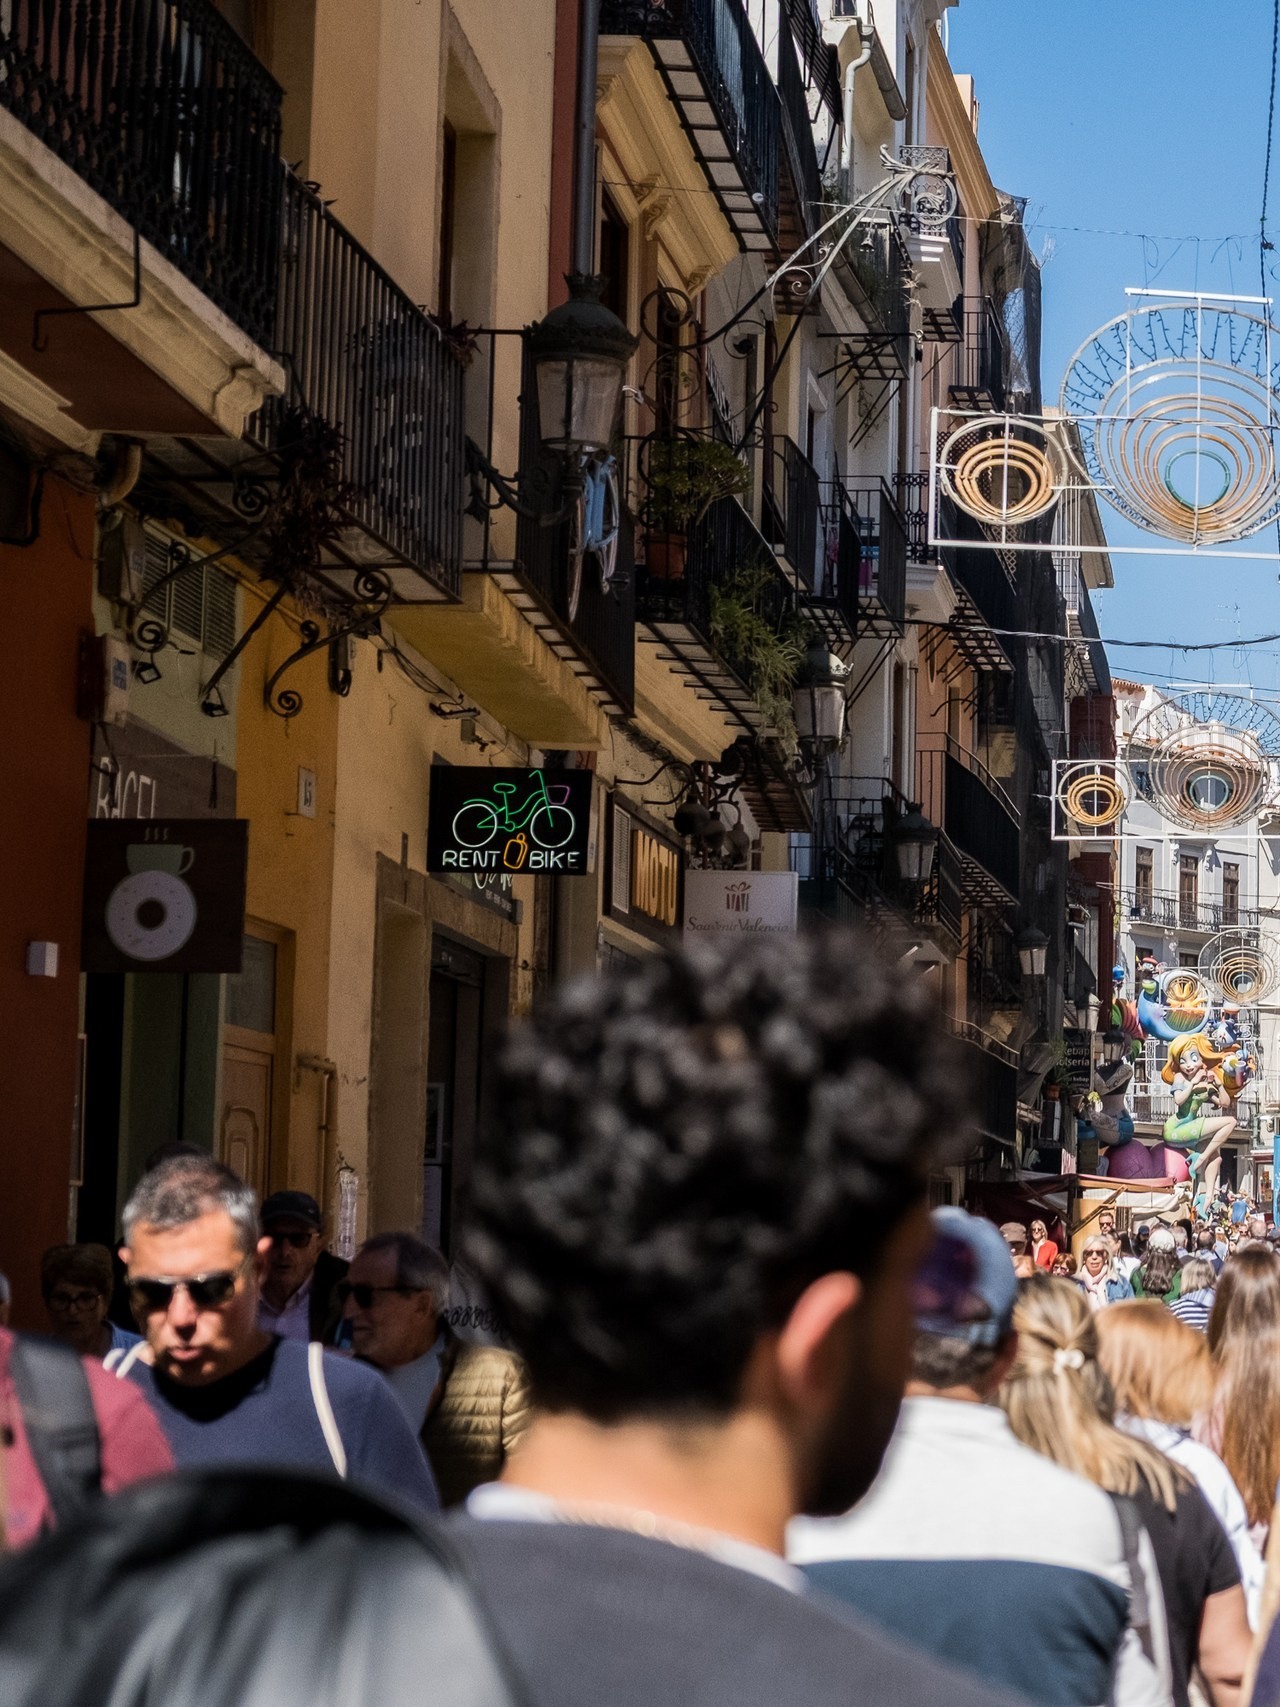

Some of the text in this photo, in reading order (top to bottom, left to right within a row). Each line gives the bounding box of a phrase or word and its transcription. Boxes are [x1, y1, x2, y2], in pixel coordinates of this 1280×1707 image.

[441, 849, 581, 870] RENT BIKE
[632, 829, 678, 927] MOTU
[738, 916, 789, 932] Valencia
